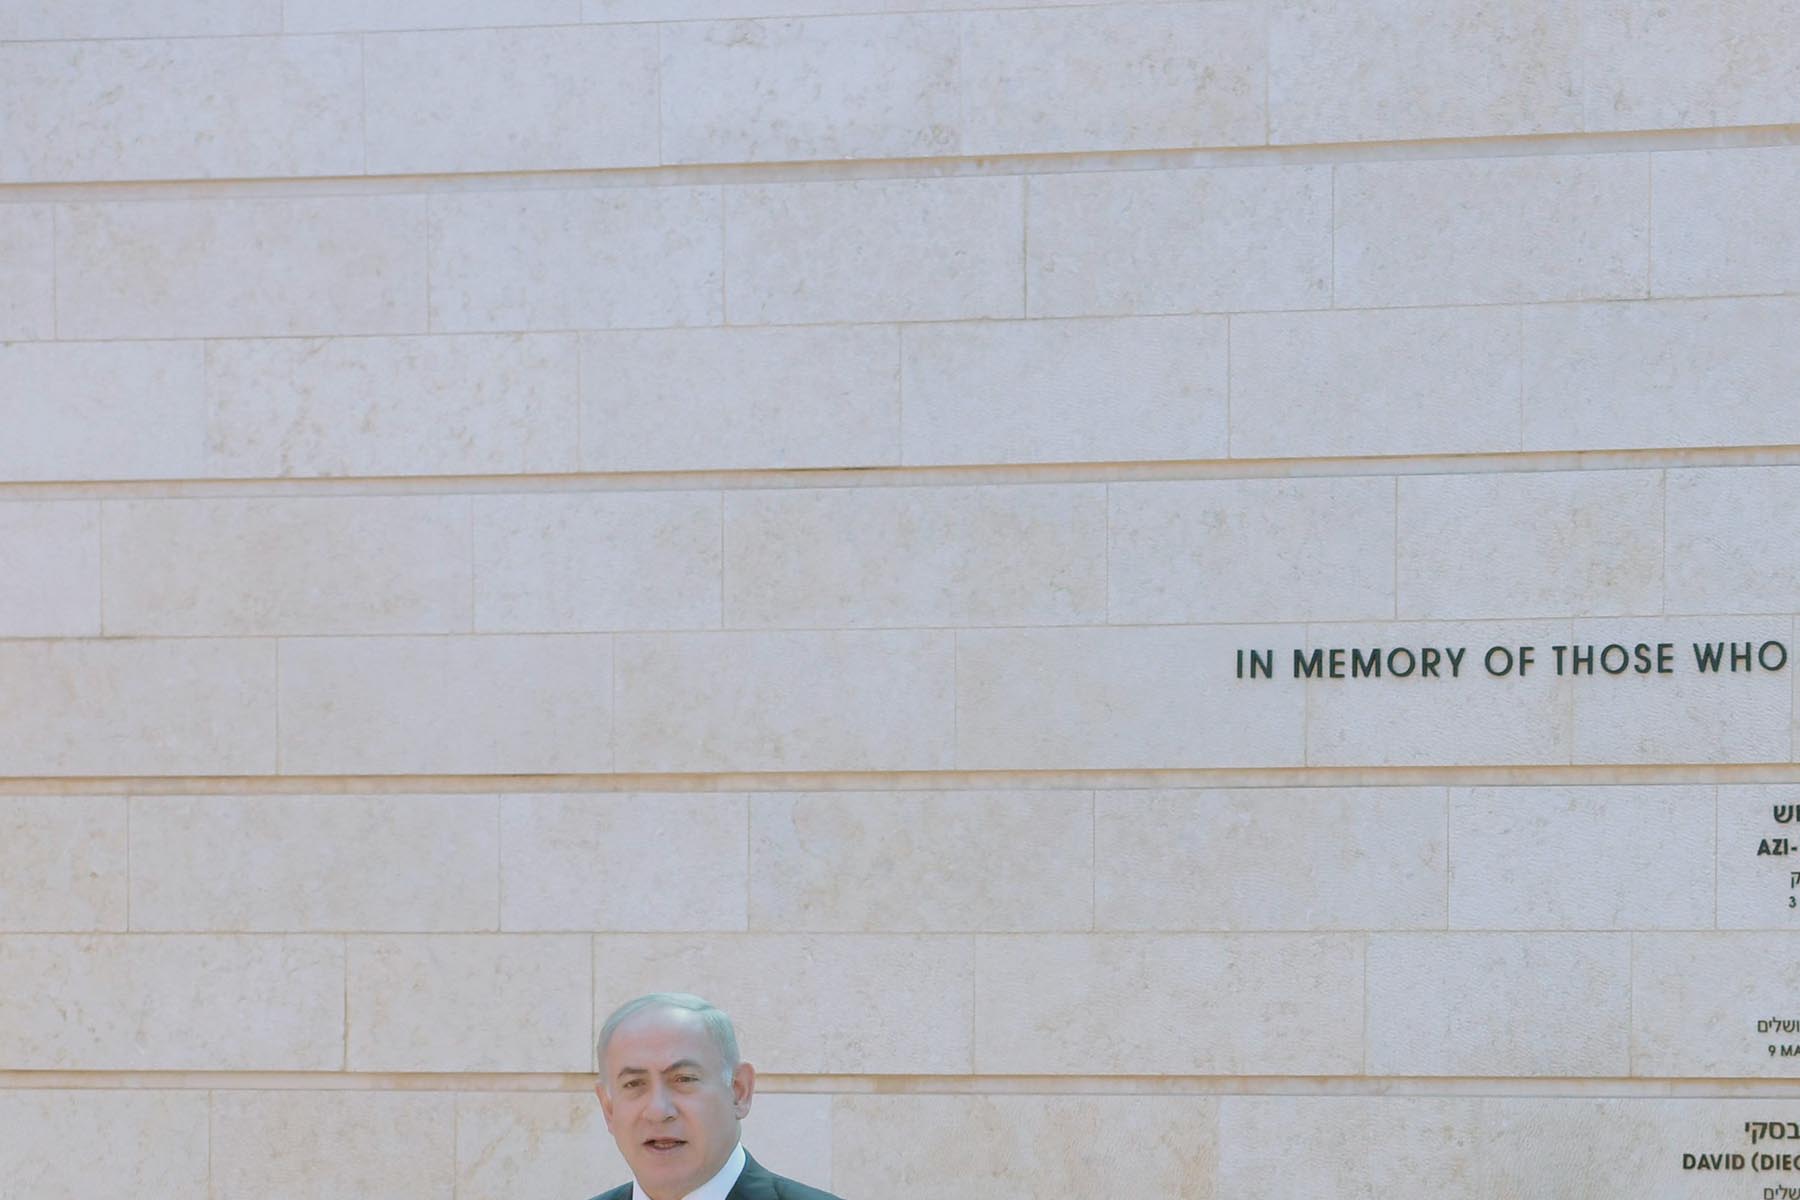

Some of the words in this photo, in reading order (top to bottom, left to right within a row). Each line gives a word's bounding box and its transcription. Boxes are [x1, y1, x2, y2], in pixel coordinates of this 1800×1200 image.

[1236, 649, 1273, 679] IN
[1293, 647, 1466, 679] MEMORY
[1484, 645, 1535, 677] OF
[1551, 643, 1674, 676] THOSE
[1692, 640, 1788, 674] WHO
[1788, 895, 1798, 909] 3
[1682, 1152, 1746, 1171] DAVID
